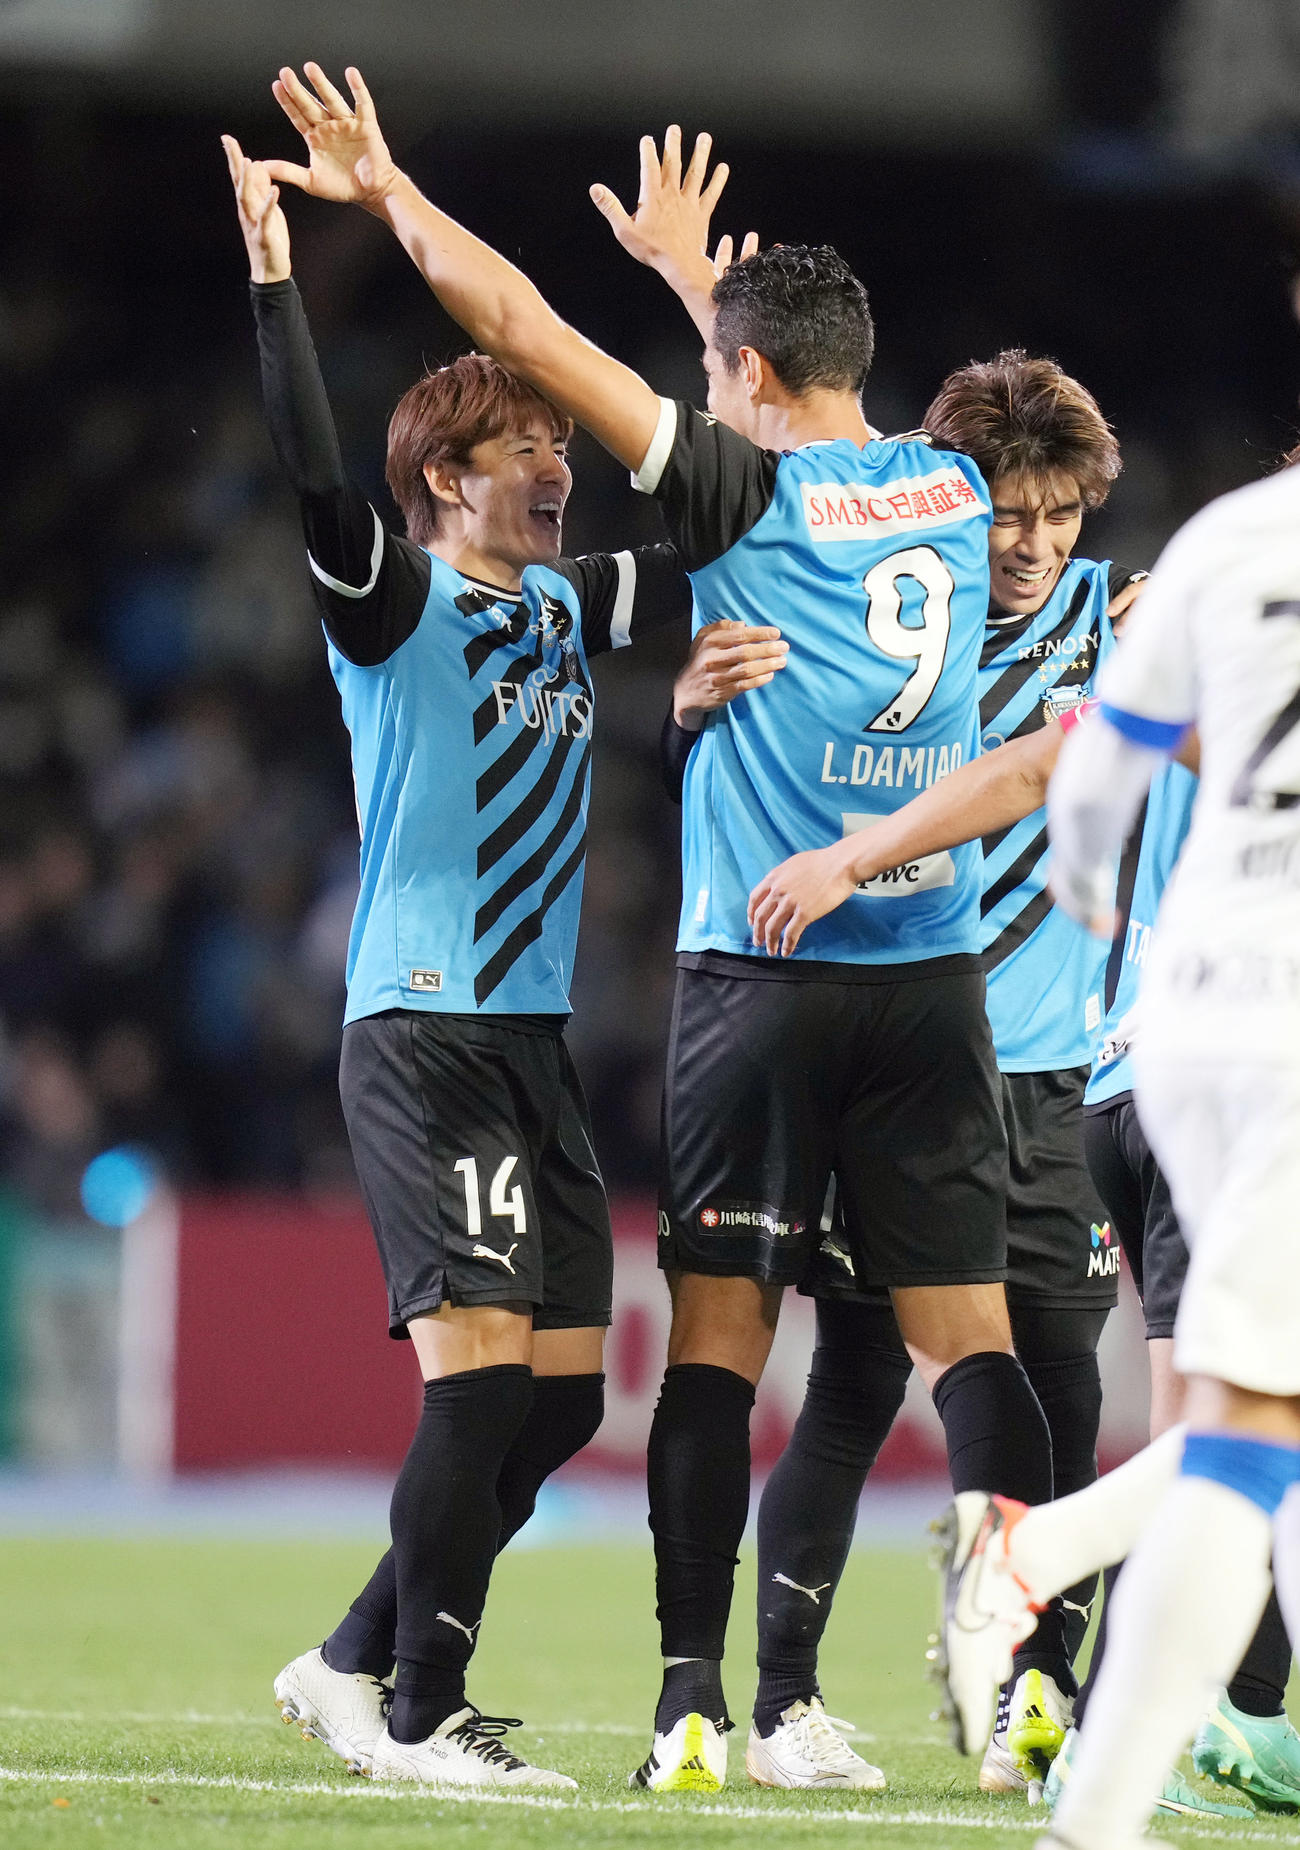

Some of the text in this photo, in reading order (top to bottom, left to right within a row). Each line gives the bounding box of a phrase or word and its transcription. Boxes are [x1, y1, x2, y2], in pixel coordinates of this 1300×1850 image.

[863, 543, 956, 734] 9
[1017, 631, 1099, 661] RENOSY
[453, 1156, 527, 1236] 14
